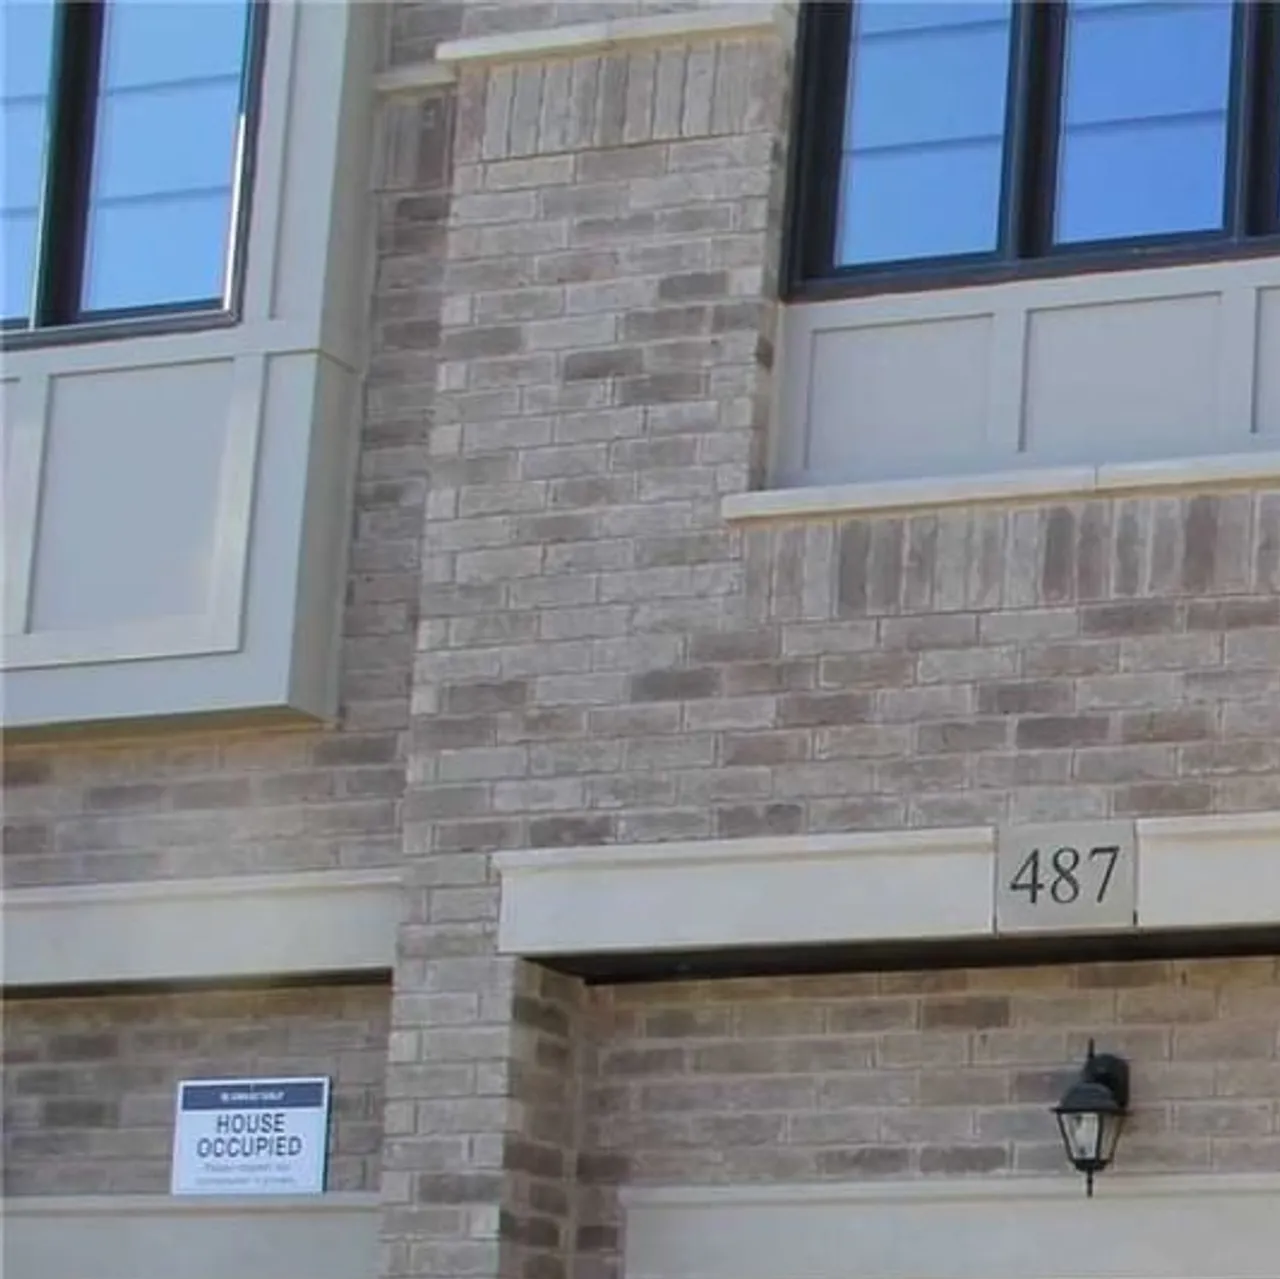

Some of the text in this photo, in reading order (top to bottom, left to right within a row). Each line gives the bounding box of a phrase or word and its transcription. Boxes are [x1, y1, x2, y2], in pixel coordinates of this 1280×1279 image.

[1009, 846, 1120, 904] 487
[216, 1112, 286, 1134] HOUSE
[196, 1135, 303, 1158] OCCUPIED
